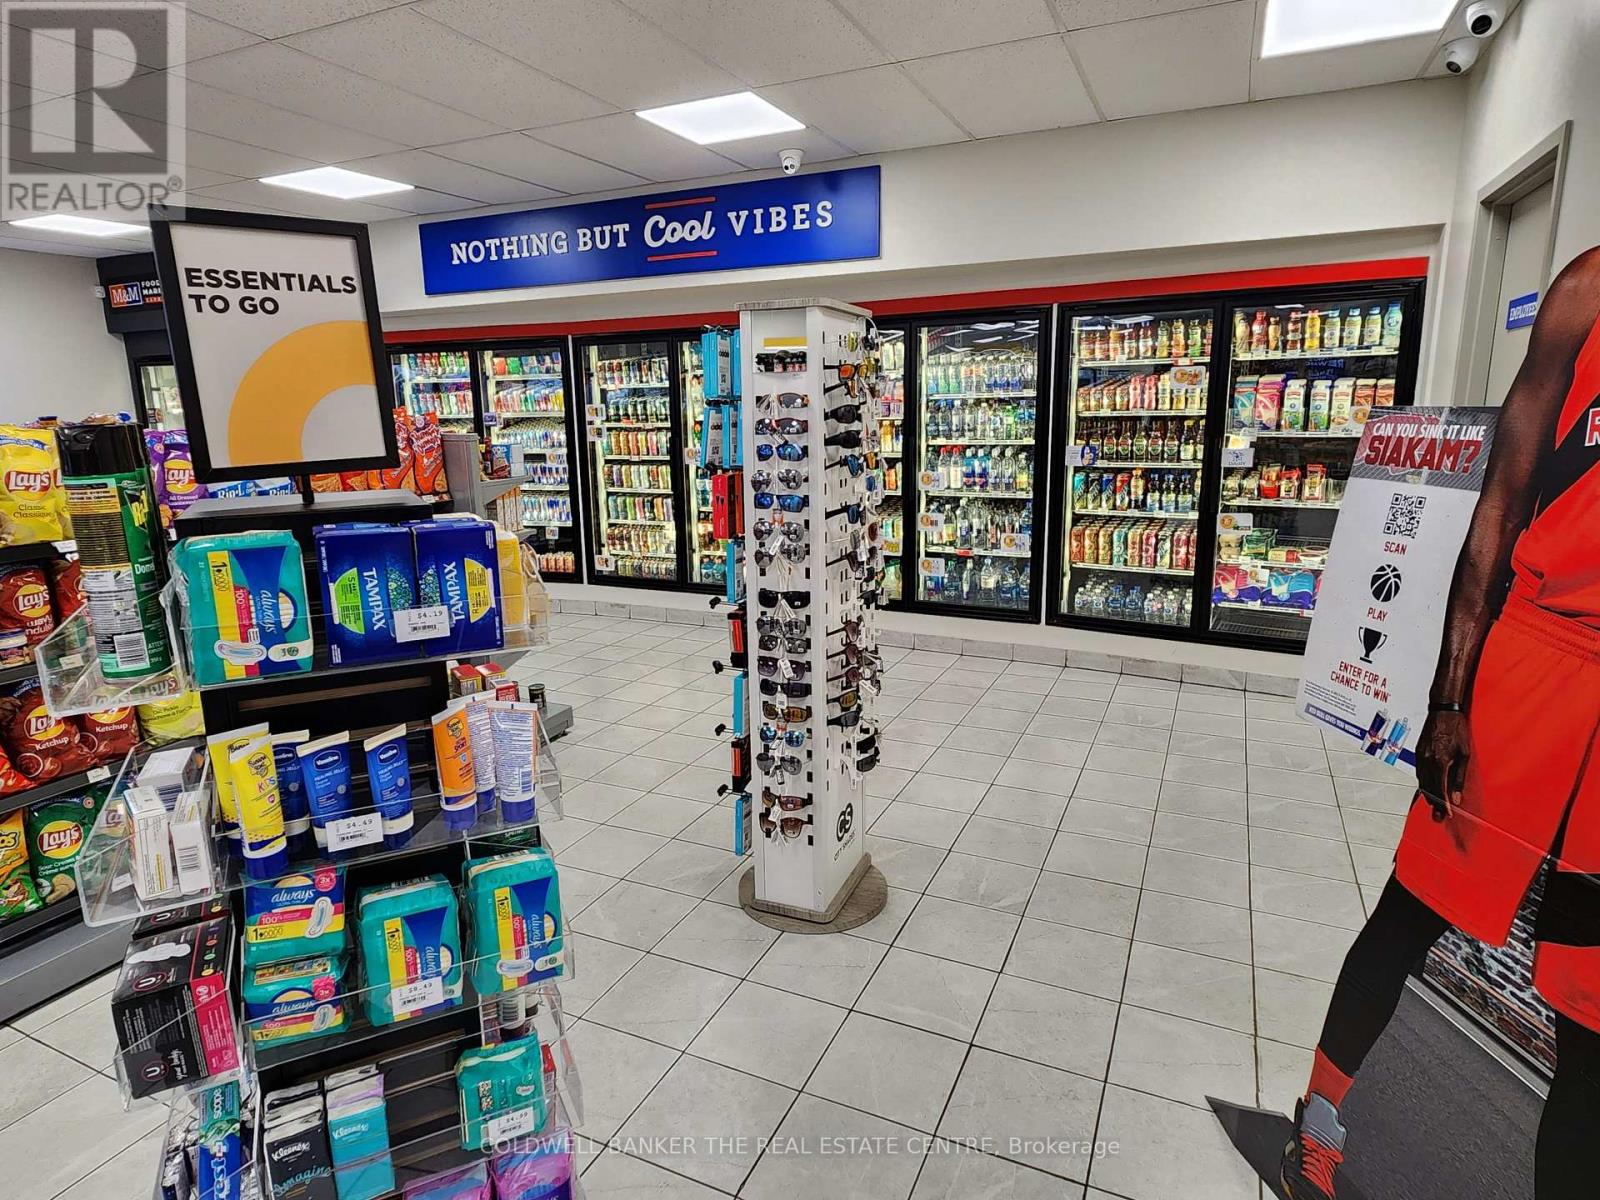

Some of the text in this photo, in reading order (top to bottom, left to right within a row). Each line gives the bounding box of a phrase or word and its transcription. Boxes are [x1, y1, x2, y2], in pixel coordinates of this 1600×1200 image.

[450, 200, 834, 266] NOTHING BUT Cool VIBES
[184, 267, 357, 294] ESSENTIALS
[111, 286, 139, 304] M&M
[188, 294, 280, 315] TO GO
[1373, 422, 1487, 441] CAN YOU SINK IT LIKE
[1364, 435, 1482, 474] SIAKAM?
[8, 470, 51, 493] Lay's
[1383, 541, 1407, 556] SCAN
[18, 585, 50, 612] Lay's
[363, 566, 387, 631] TAMPAX
[443, 561, 466, 621] TAMPAX
[259, 589, 278, 635] always
[417, 610, 443, 620] $4.19
[1367, 607, 1388, 622] PLAY
[1330, 670, 1360, 691] CHANCE
[1361, 683, 1372, 696] TO
[1339, 661, 1387, 689] ENTER FOR A
[95, 722, 129, 734] Ketchup
[35, 734, 70, 751] Ketchup
[346, 818, 374, 829] $4.49
[271, 888, 317, 903] always
[530, 913, 544, 950] always
[272, 1000, 317, 1015] always
[213, 1088, 225, 1119] scope
[332, 1122, 369, 1139] Kleenex
[271, 1142, 311, 1161] Kleenex
